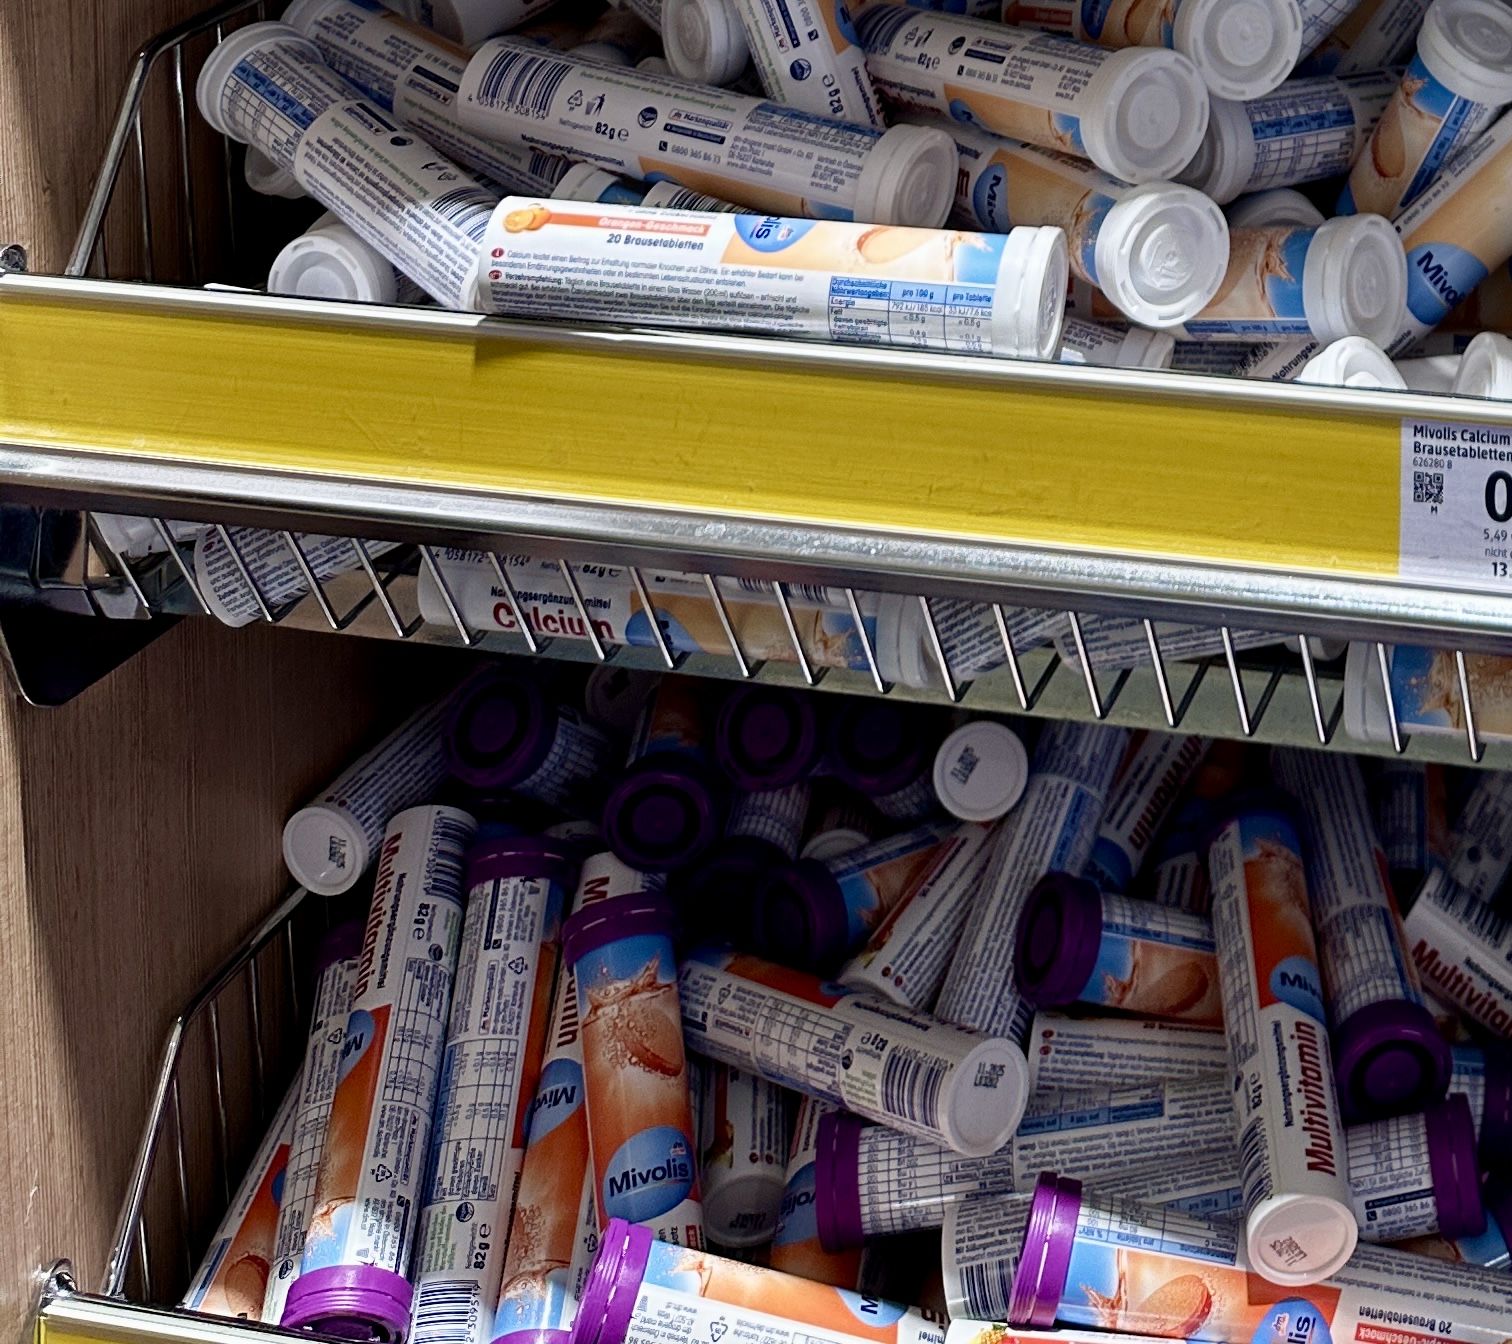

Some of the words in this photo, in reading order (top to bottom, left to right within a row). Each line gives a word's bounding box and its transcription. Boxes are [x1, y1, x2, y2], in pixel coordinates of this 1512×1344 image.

[598, 217, 707, 235] Orangen-Geschmack
[607, 233, 621, 245] 20
[624, 235, 704, 251] Brausetabletten
[1413, 425, 1457, 442] Mivolis
[1460, 428, 1511, 446] Calcium
[1483, 528, 1508, 543] 5,49
[1484, 546, 1508, 559] nicht
[354, 831, 403, 1002] Multivitamin
[1295, 1020, 1337, 1177] Multivitamin
[609, 1157, 690, 1197] Mivolis
